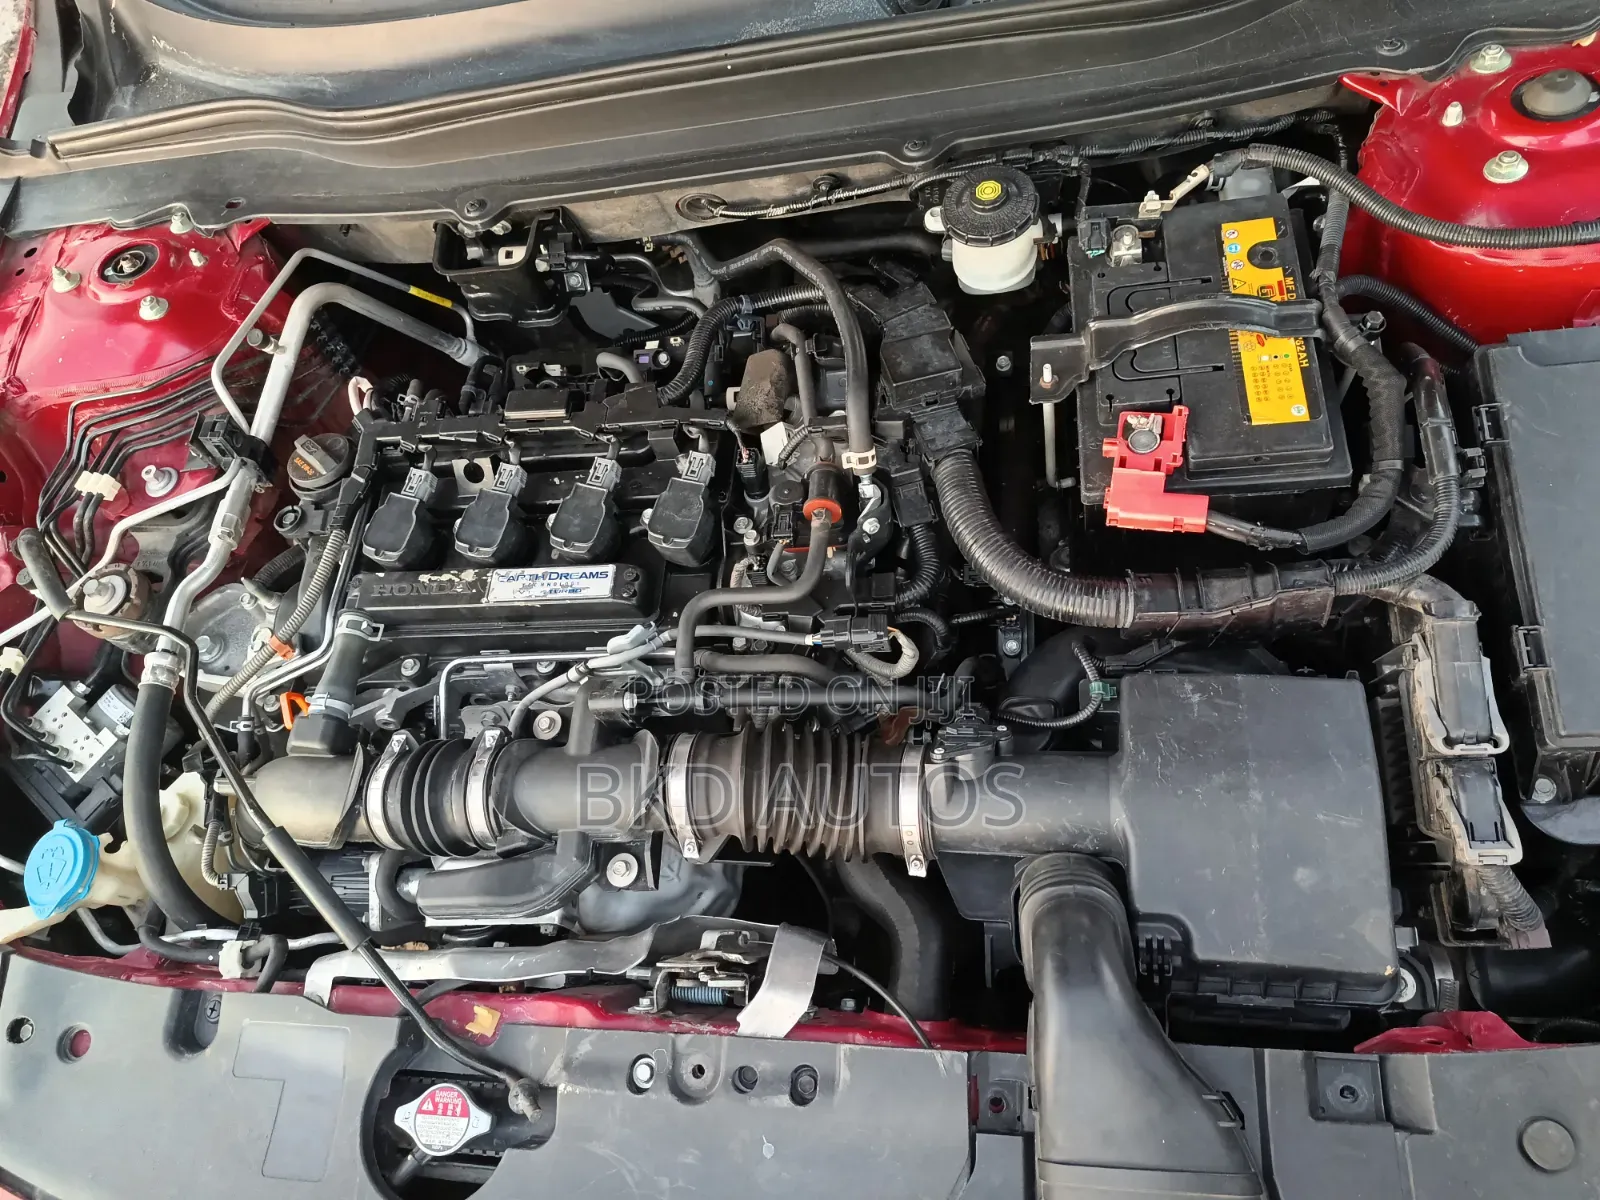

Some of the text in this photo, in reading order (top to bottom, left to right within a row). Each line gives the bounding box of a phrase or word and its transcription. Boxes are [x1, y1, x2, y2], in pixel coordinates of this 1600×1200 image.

[1285, 276, 1295, 291] MF
[1295, 336, 1310, 368] 62AH
[548, 571, 609, 581] DREAMS
[371, 580, 471, 597] HONDA
[435, 1090, 458, 1098] DANGER
